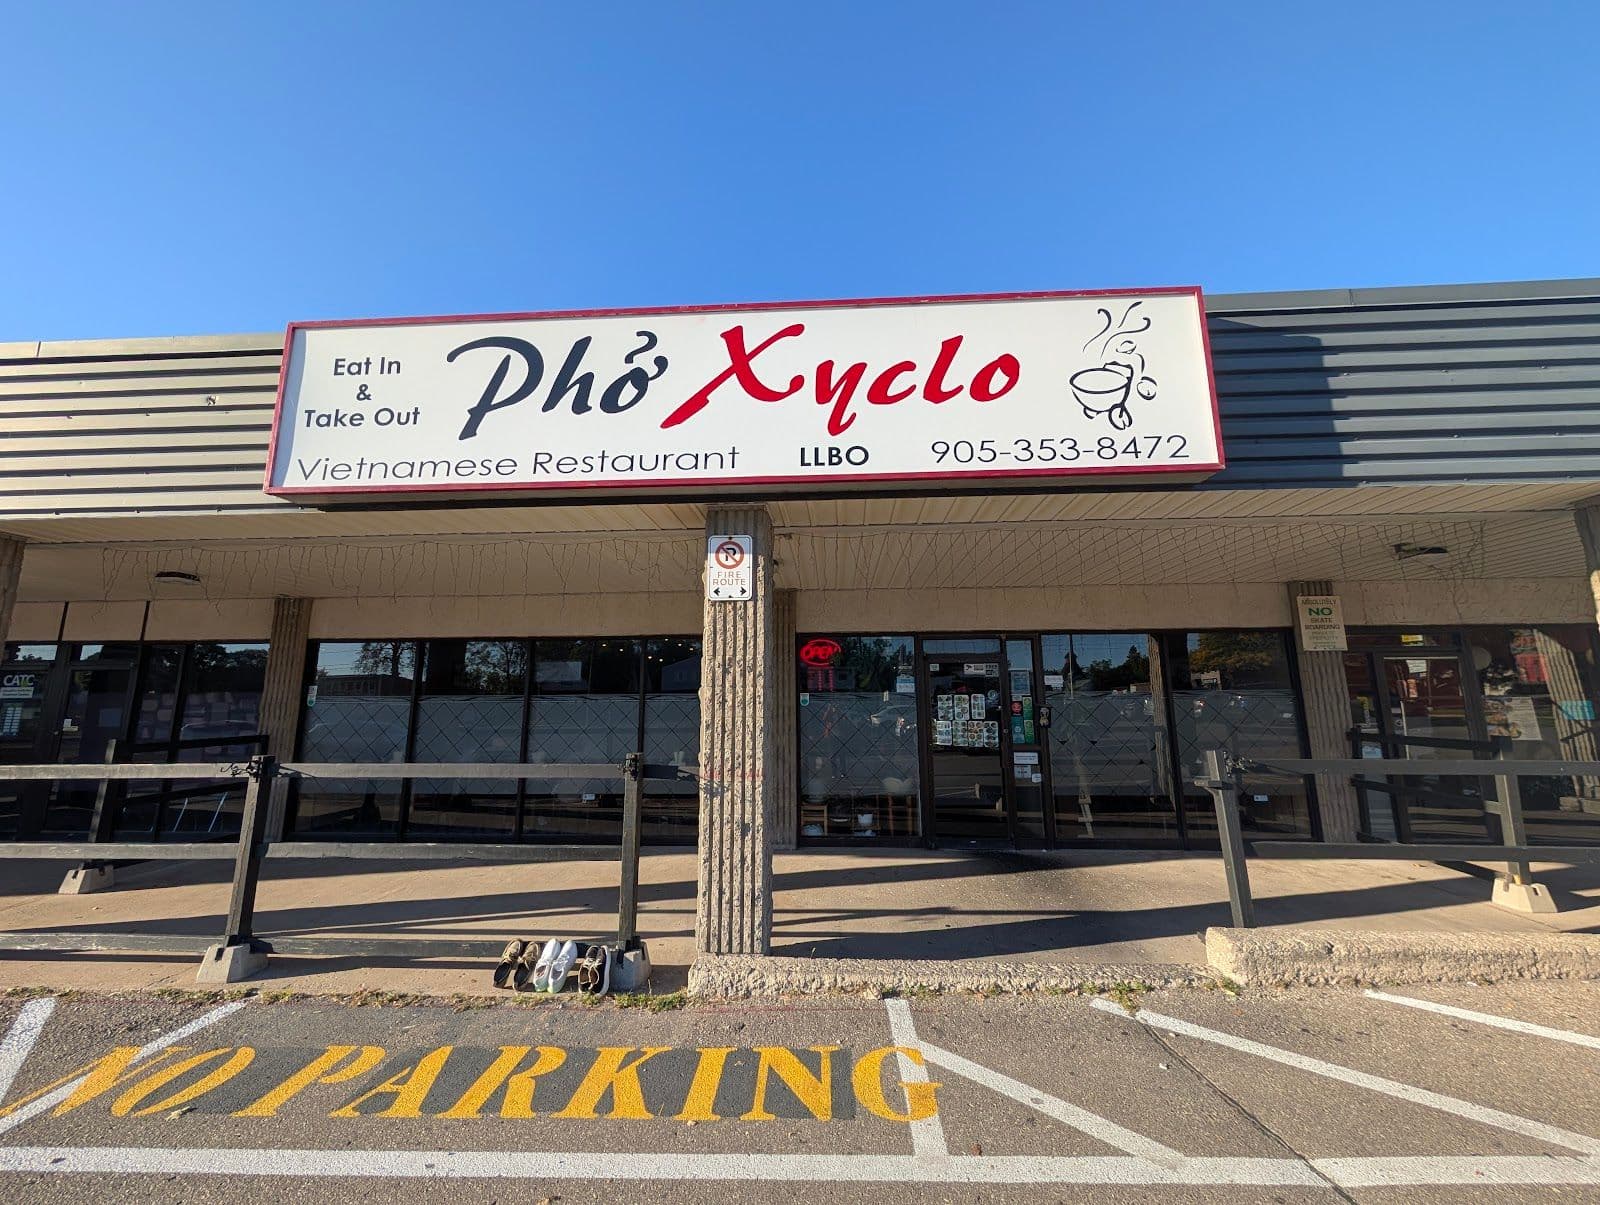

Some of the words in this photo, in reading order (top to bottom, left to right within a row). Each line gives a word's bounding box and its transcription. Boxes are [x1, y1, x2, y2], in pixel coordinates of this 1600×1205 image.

[333, 357, 372, 376] Eat
[380, 357, 401, 375] In
[660, 323, 1020, 436] Xyclo
[356, 384, 372, 401] &
[304, 408, 365, 428] Take
[374, 407, 421, 427] Out
[800, 446, 870, 467] LLBO
[931, 435, 1190, 464] 905-353-8472
[298, 457, 518, 481] Vietnamese
[533, 446, 740, 474] Restaurant
[712, 578, 747, 586] ROUTE
[717, 571, 742, 579] FIRE
[1308, 607, 1333, 616] NO
[0, 1046, 256, 1117] NO
[232, 1045, 939, 1121] PARKING
